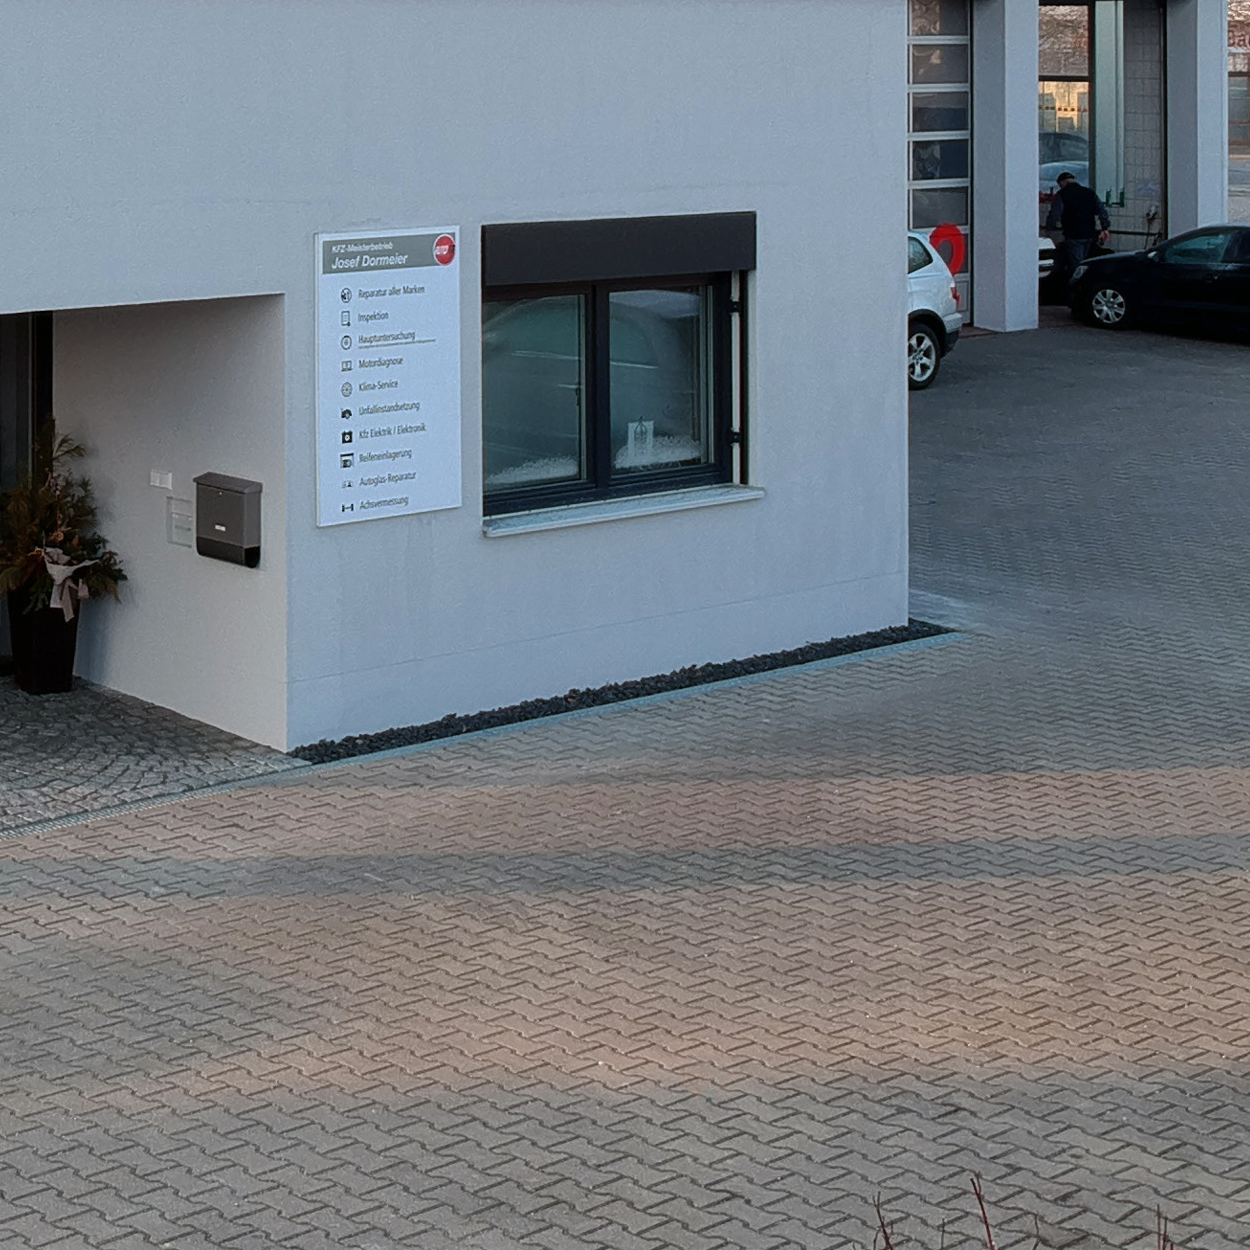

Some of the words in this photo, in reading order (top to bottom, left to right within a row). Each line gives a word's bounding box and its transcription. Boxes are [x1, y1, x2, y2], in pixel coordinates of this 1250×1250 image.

[331, 255, 360, 269] Josef
[361, 252, 409, 267] Dormeier
[358, 289, 387, 299] Reparatur
[388, 287, 402, 296] aller
[403, 285, 425, 294] Marken
[358, 311, 389, 323] Inspektion
[358, 331, 416, 343] Hauptuntersuchung
[359, 357, 404, 368] Motordiagnose
[359, 379, 398, 391] Klima-Service
[359, 402, 420, 415] Unfallinstandsetzung
[370, 427, 392, 438] Elektrik
[397, 423, 426, 434] Elektronik
[359, 450, 412, 462] Reifeneinlagerung
[359, 496, 408, 510] Achsvermessung
